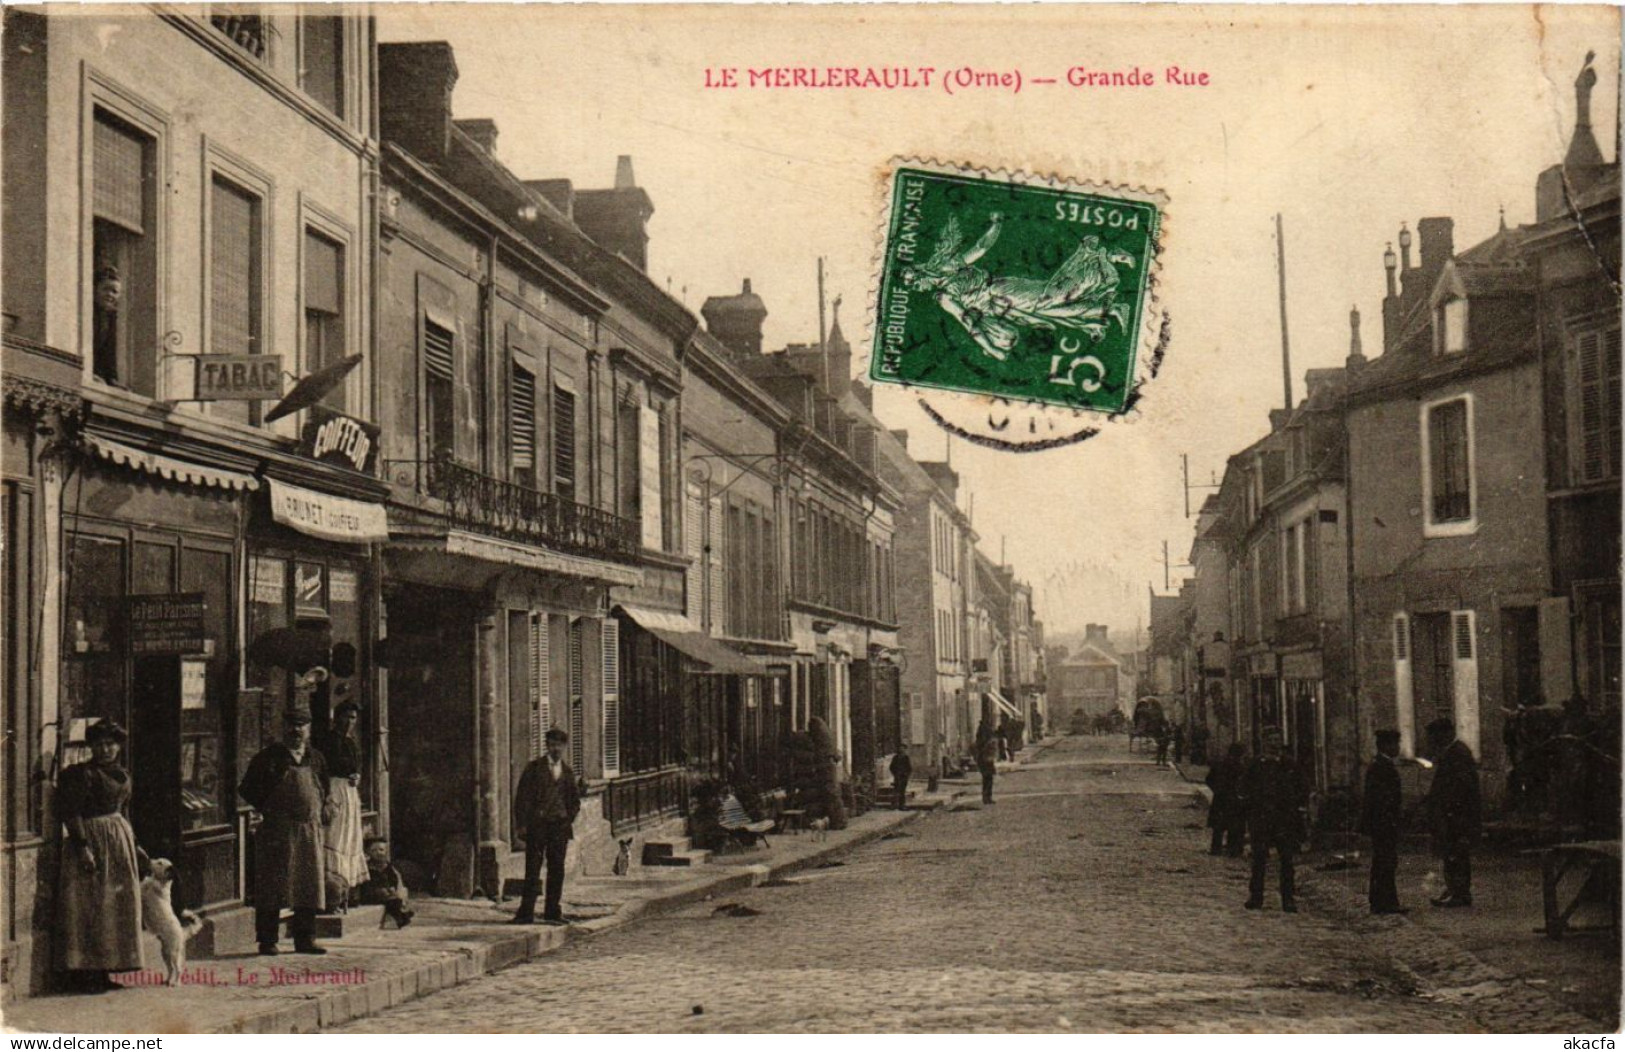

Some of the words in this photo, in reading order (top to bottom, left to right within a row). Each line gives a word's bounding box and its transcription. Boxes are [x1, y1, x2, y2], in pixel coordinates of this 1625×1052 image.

[1055, 201, 1139, 230] POSTES
[204, 362, 281, 391] TABAC
[313, 416, 371, 472] COIFFEUR
[286, 496, 323, 526] BRUNET
